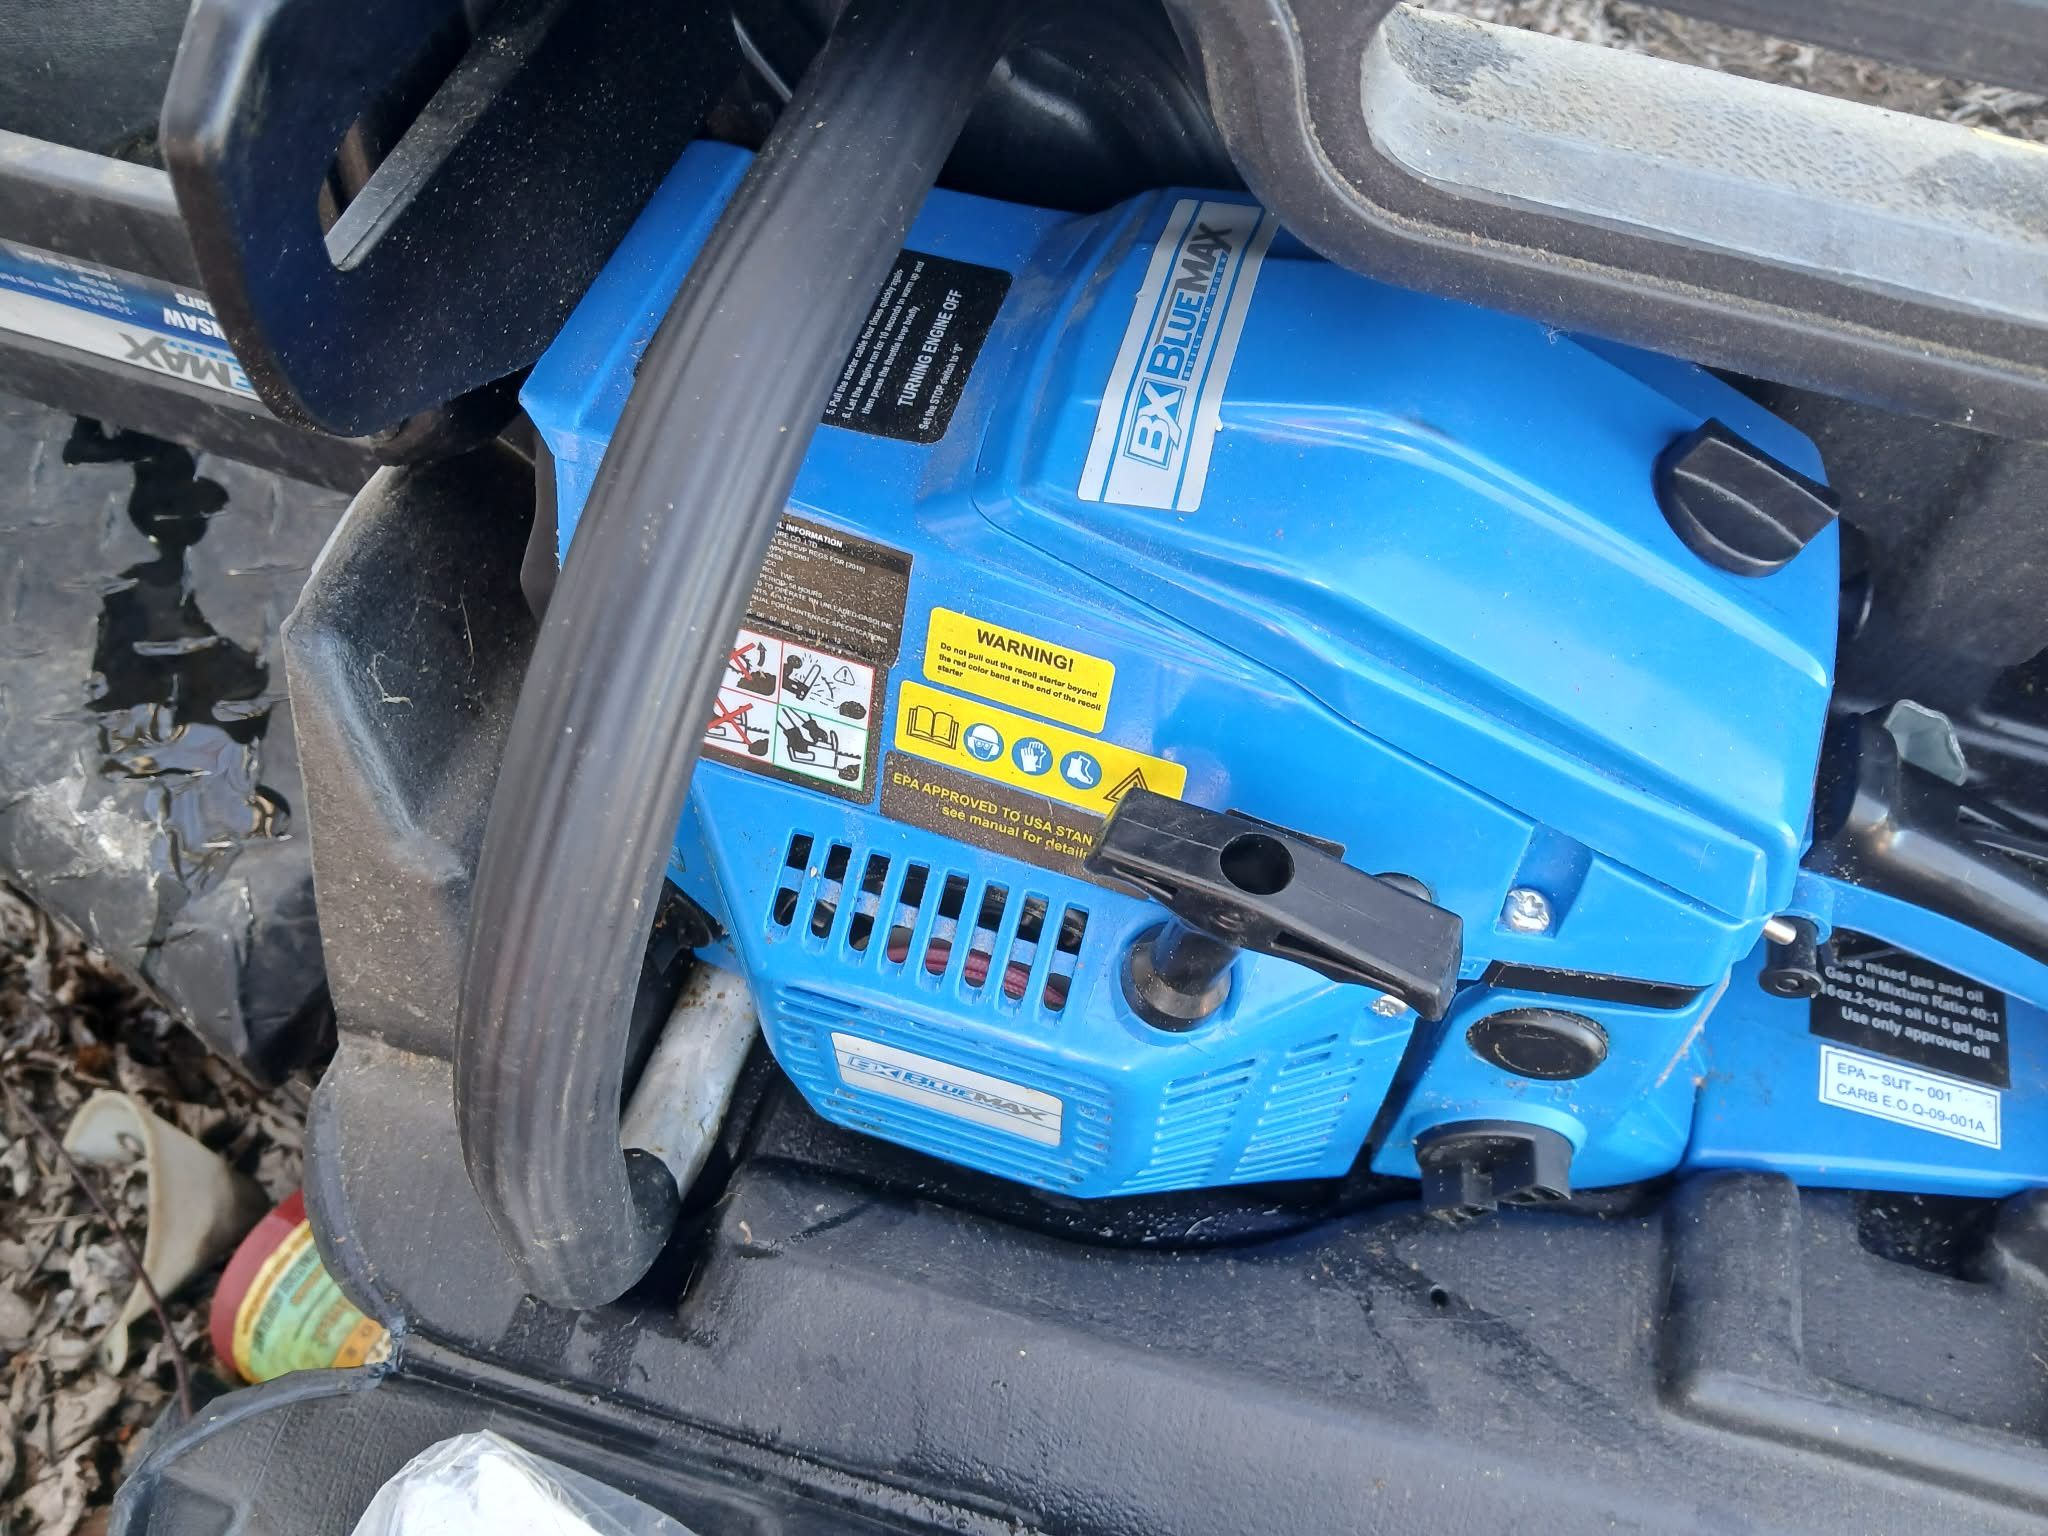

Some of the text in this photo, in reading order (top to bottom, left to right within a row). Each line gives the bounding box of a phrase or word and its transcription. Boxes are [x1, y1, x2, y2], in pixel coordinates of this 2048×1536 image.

[912, 272, 920, 280] up
[915, 260, 925, 272] and
[903, 280, 914, 297] warm
[884, 304, 903, 331] seconds
[875, 340, 885, 350] for
[880, 331, 888, 339] 10
[1183, 334, 1203, 378] BUILT
[1200, 305, 1212, 323] TO
[830, 391, 842, 407] Pull
[837, 380, 848, 391] the
[843, 357, 859, 379] starter
[854, 339, 868, 357] cable
[864, 325, 875, 339] four
[871, 308, 883, 325] times
[880, 285, 896, 307] quickly
[871, 350, 880, 362] run
[896, 288, 963, 407] TURNING ENGINE OFF
[863, 305, 920, 414] then press the throttle lever briefly
[948, 354, 959, 362] to
[858, 362, 876, 386] engine
[937, 362, 956, 384] switch
[853, 385, 863, 397] the
[928, 384, 946, 404] STOP
[847, 397, 857, 410] Let
[923, 404, 937, 416] the
[917, 416, 932, 429] Set
[1126, 378, 1184, 465] BX
[785, 524, 842, 547] INFORMATION
[808, 549, 829, 560] REGS
[829, 556, 845, 566] FOR
[750, 593, 769, 604] NUAL
[769, 600, 784, 608] FOR
[774, 585, 807, 601] OPERATE
[797, 586, 823, 598] HOURS
[977, 628, 1074, 672] WARNING!
[937, 663, 963, 677] starter
[940, 642, 1097, 699] Do not pull out the recoil starter beyond
[938, 653, 1101, 711] the red color band at the end of the recoil
[892, 772, 1093, 846] EPA APPROVED TO USA STAN
[941, 805, 966, 820] see
[969, 813, 1019, 837] manual
[1022, 829, 1042, 844] for
[1865, 962, 1906, 980] mixed
[1910, 975, 1934, 988] gas
[1937, 982, 1963, 995] and
[1966, 989, 1983, 1001] oil
[1825, 965, 1998, 1022] Gas Oil Mixture Ratio 40:1
[1904, 1006, 1921, 1018] oil
[1924, 1012, 1937, 1023] to
[1941, 1016, 1950, 1027] 5
[1842, 1007, 1990, 1057] Use only approved oil
[1837, 1061, 1866, 1079] EPA
[1881, 1073, 1910, 1092] SUT
[1927, 1086, 1950, 1102] 001
[1836, 1082, 1877, 1103] CARB
